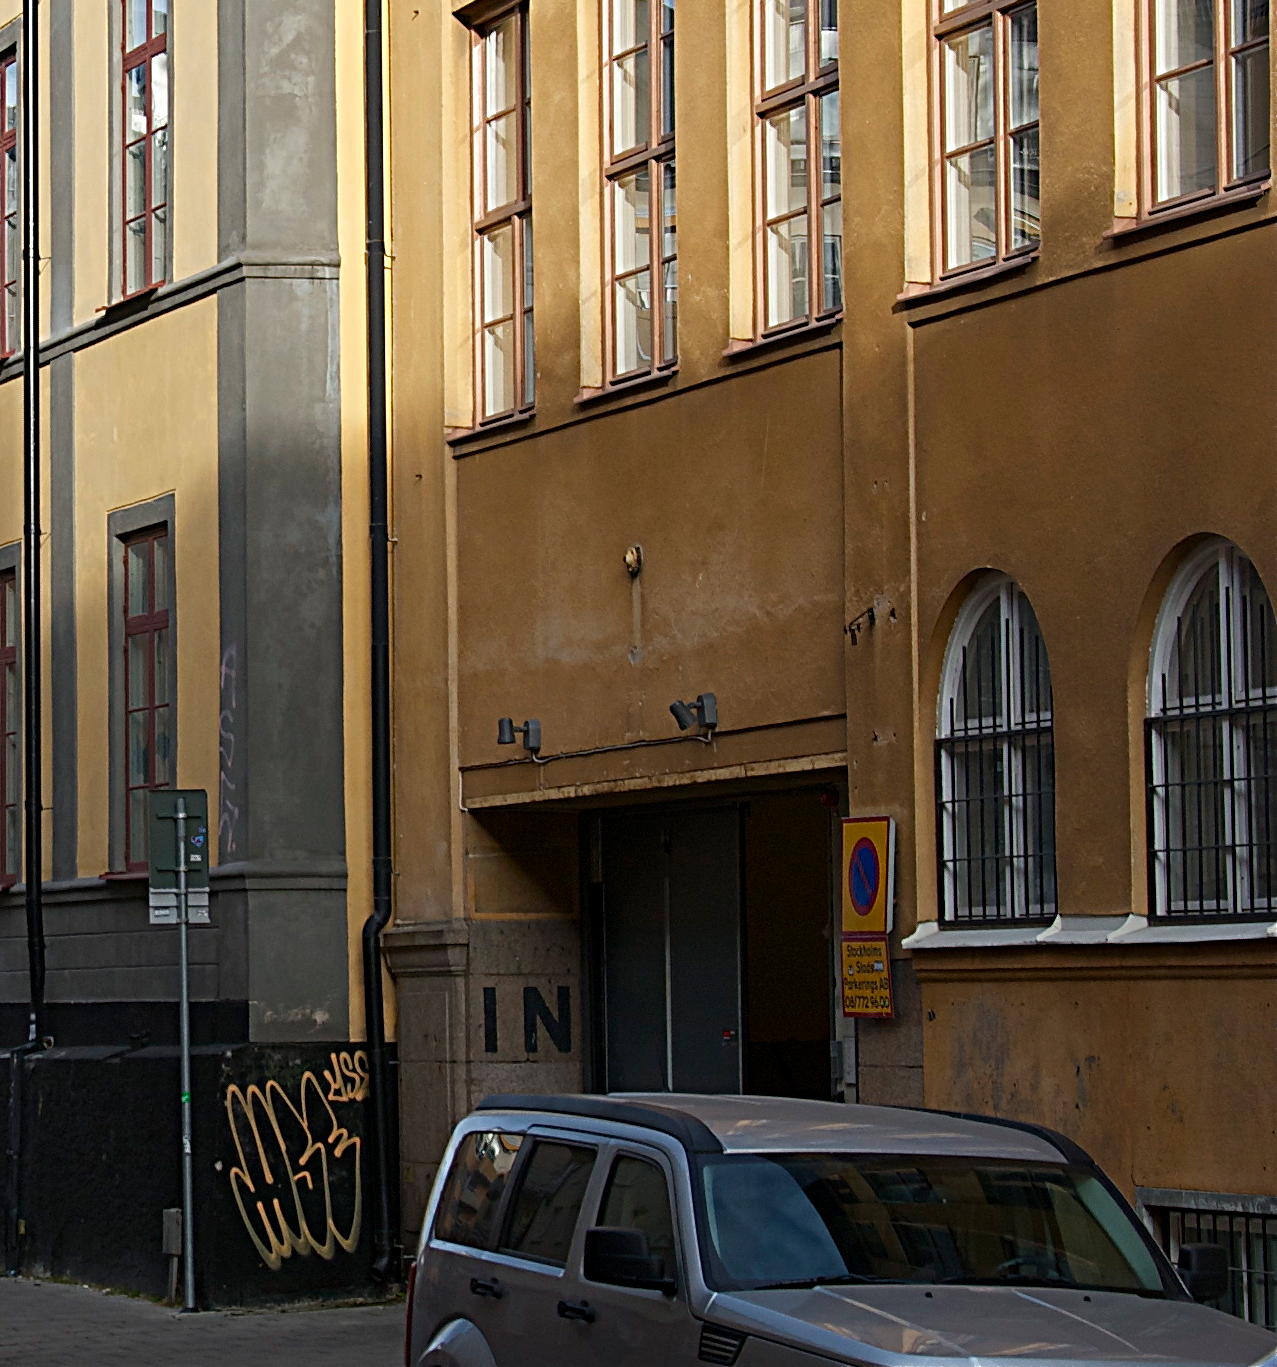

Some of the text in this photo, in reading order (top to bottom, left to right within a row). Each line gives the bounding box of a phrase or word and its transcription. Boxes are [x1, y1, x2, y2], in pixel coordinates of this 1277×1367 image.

[847, 944, 882, 957] Stockholms
[843, 977, 889, 994] Parkerings AB
[483, 986, 572, 1053] IN
